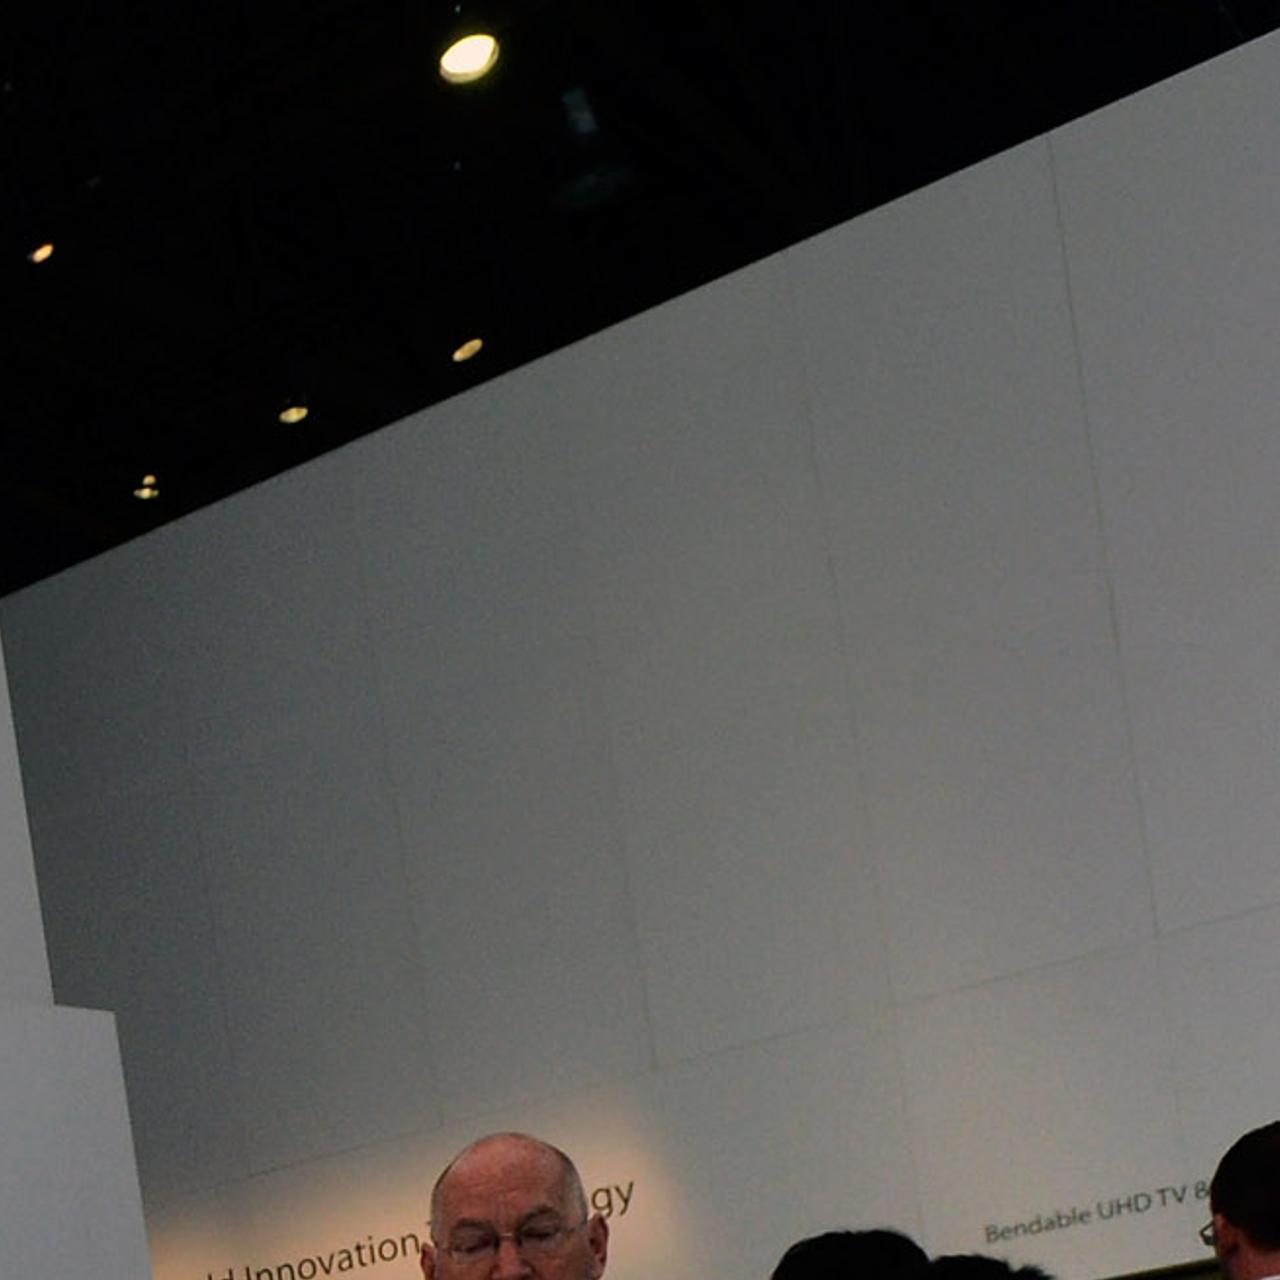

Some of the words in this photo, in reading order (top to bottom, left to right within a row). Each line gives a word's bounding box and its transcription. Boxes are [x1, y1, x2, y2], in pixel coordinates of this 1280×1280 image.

[984, 1204, 1091, 1244] Bendable
[1096, 1191, 1152, 1221] UHD
[1158, 1184, 1189, 1207] TV
